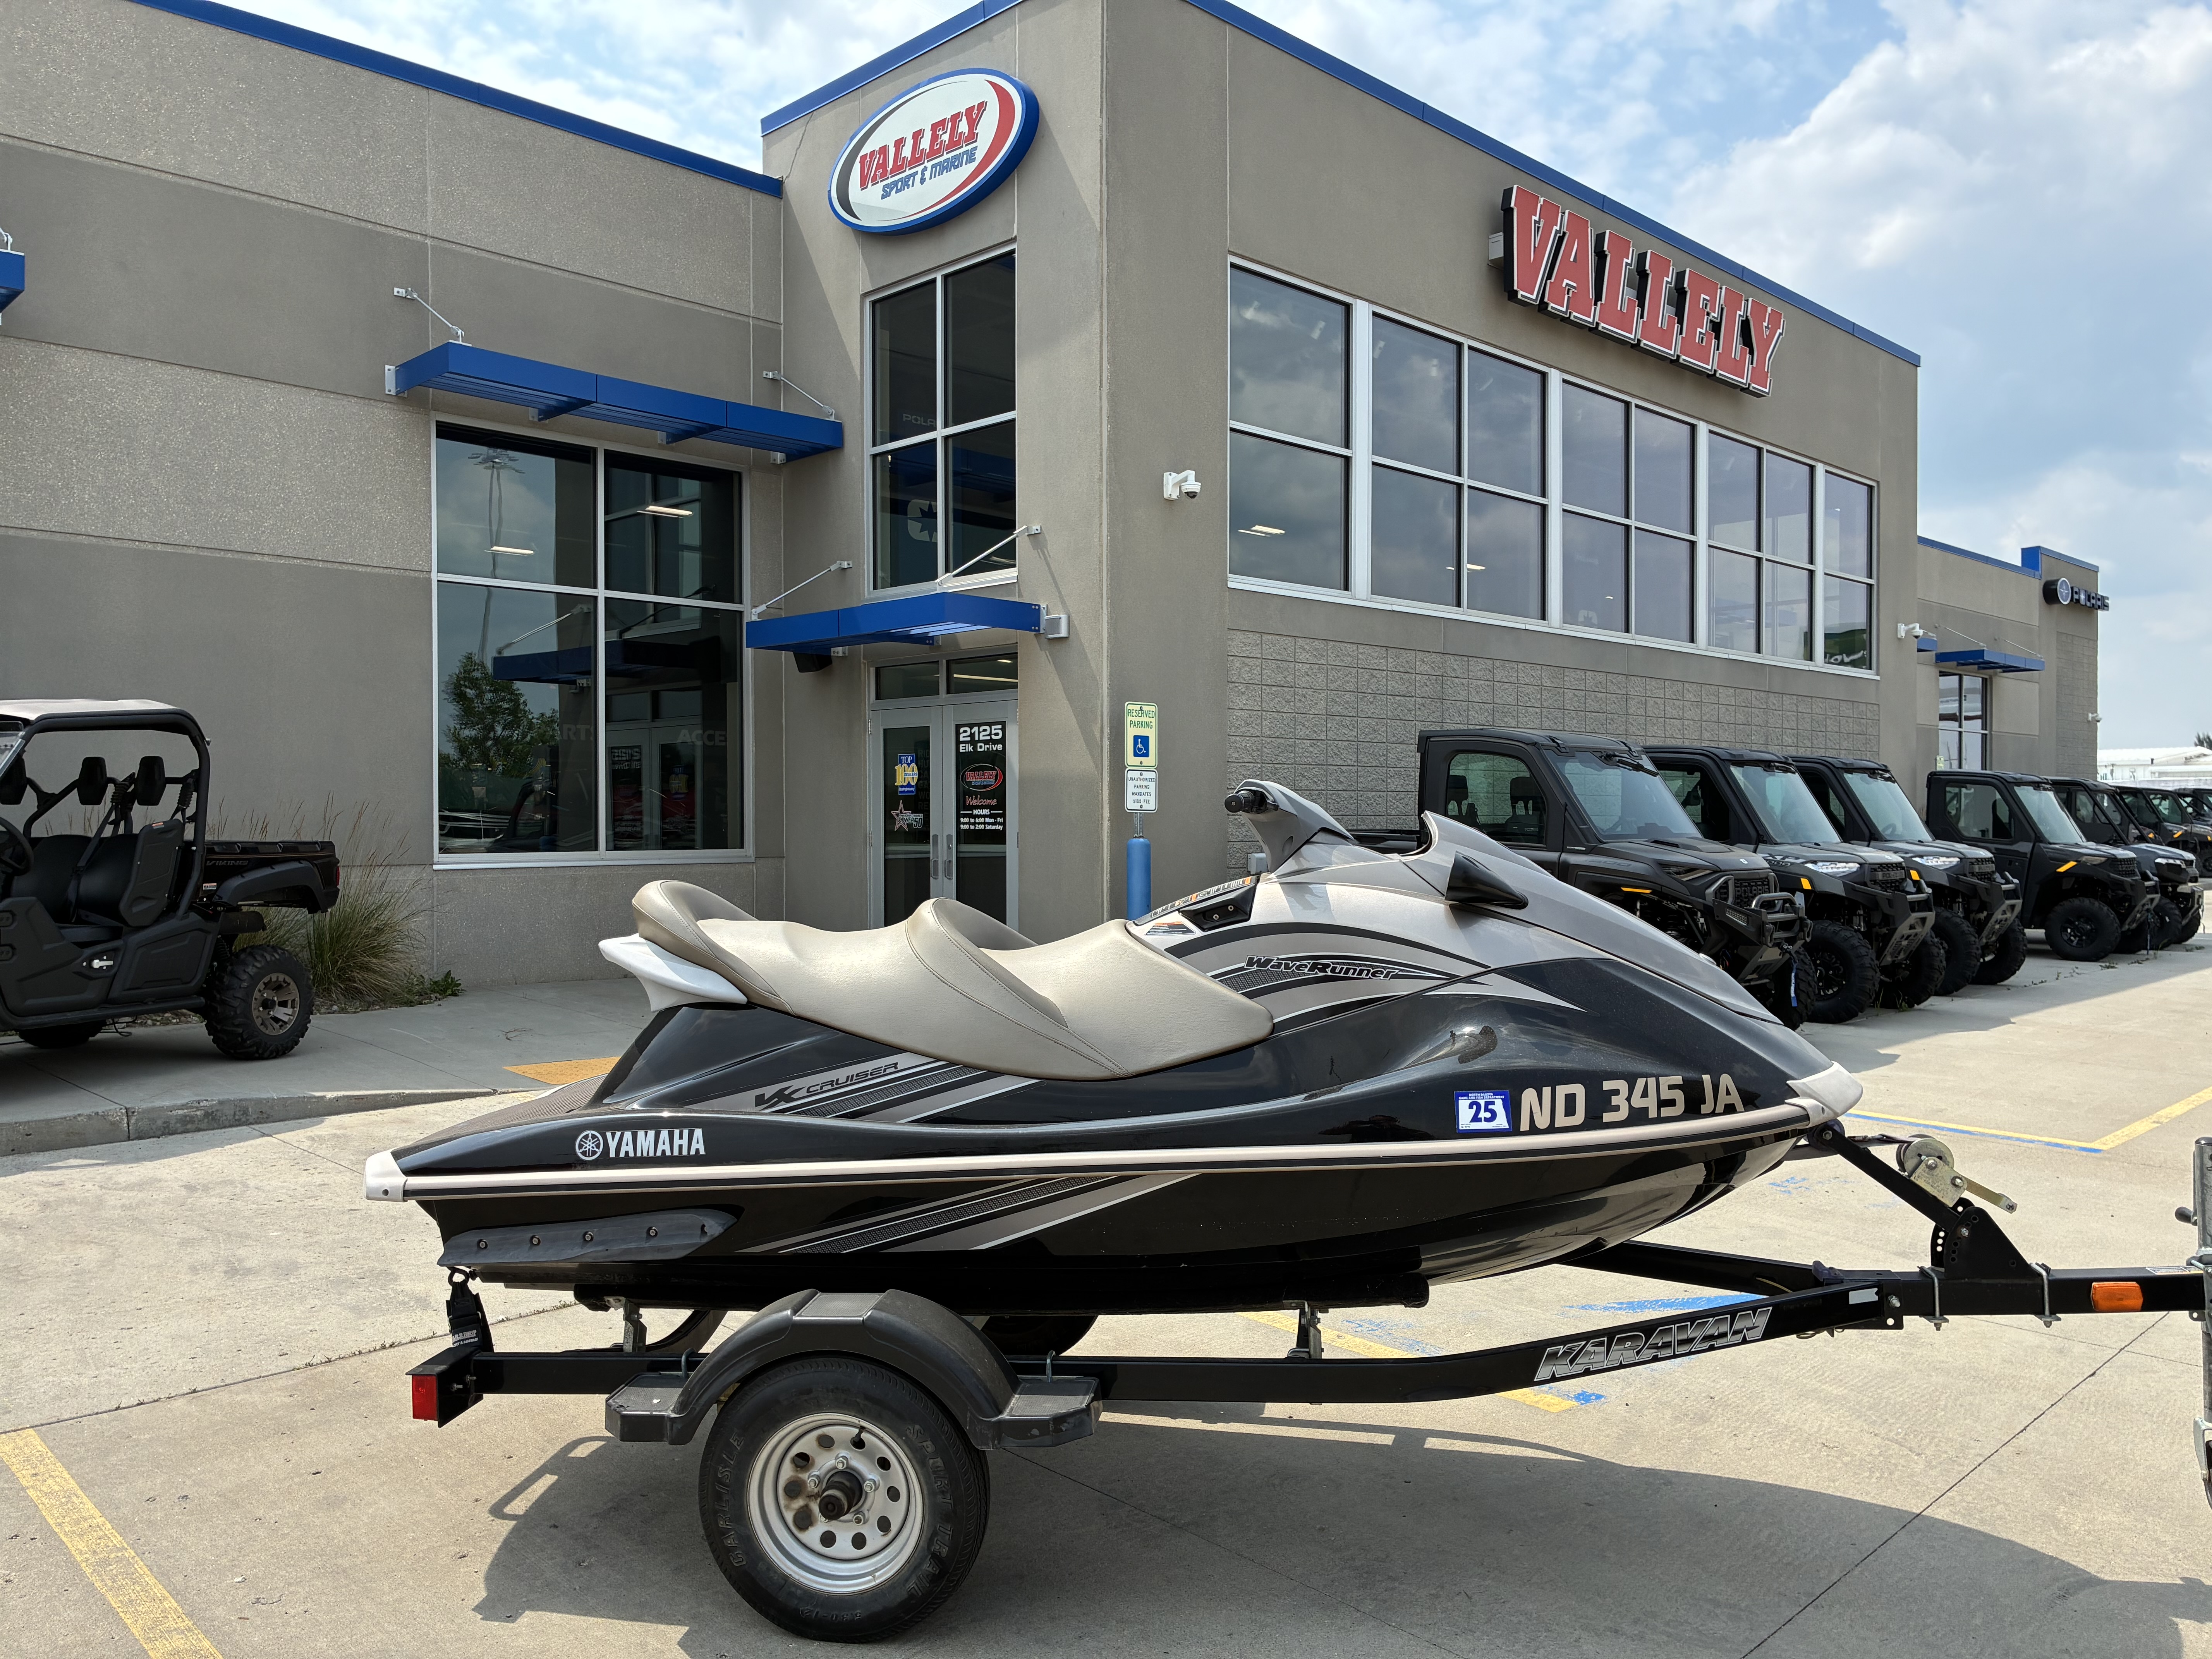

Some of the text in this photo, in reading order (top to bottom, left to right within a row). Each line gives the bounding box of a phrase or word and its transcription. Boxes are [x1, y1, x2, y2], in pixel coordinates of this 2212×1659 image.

[859, 100, 988, 191] VALLELY
[881, 146, 978, 200] SPORT & MARINE
[1501, 184, 1786, 398] VALLELY
[2071, 586, 2109, 611] POLARIS
[1128, 709, 1155, 718] RESERVED
[1130, 720, 1153, 729] PARKING
[960, 725, 1003, 741] 2125
[960, 742, 1003, 752] Elk Drive
[895, 763, 918, 786] 100
[966, 771, 997, 781] VALLELY
[966, 795, 997, 805] Welcome
[914, 817, 923, 828] 50
[1735, 885, 1769, 897] POLARIS
[1244, 955, 1400, 981] WaveRunner
[806, 1061, 898, 1094] CRUISER
[1468, 1101, 1497, 1123] 25
[1520, 1073, 1744, 1132] ND 345 JA
[606, 1128, 705, 1158] YAMAHA
[1534, 1306, 1773, 1381] KARAVAN
[905, 1424, 954, 1596] SPORT TRAIL
